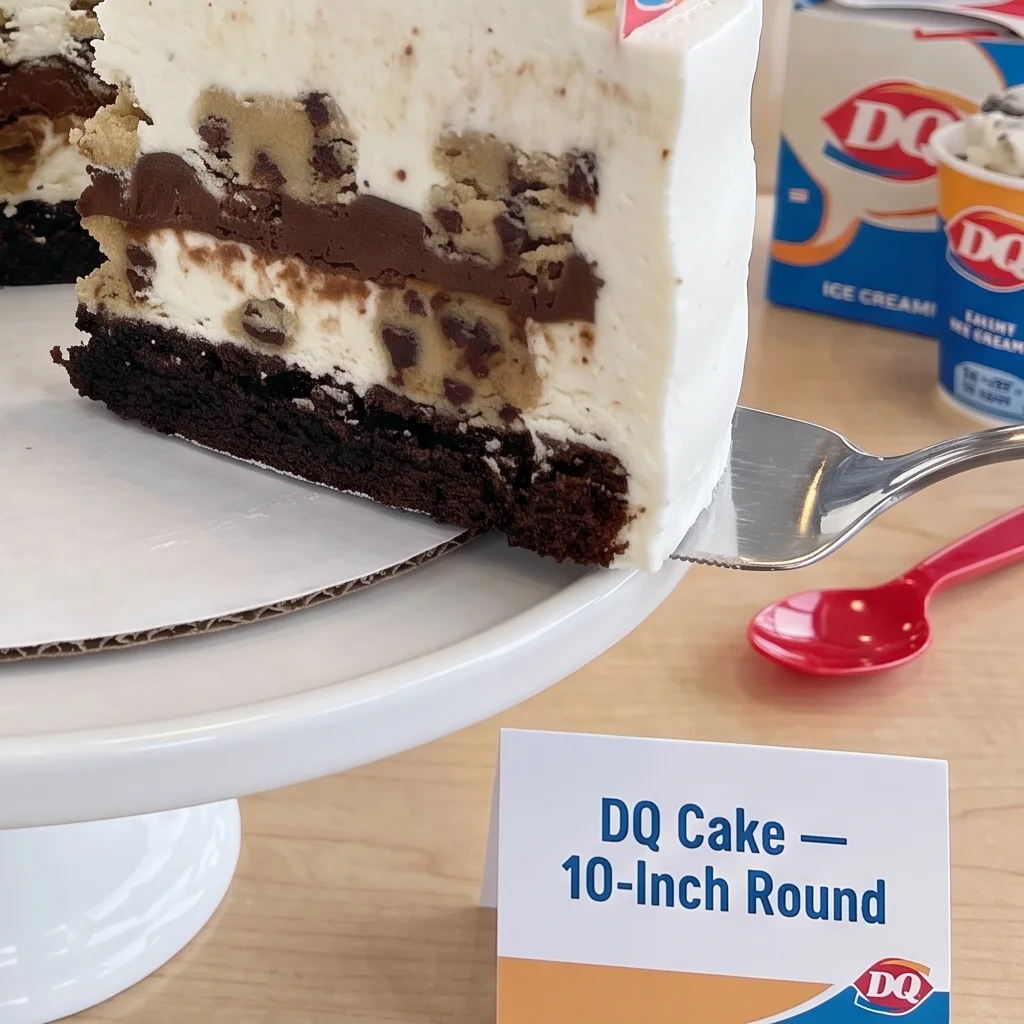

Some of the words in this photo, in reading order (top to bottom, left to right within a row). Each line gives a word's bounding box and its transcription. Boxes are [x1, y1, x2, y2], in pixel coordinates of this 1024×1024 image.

[844, 99, 956, 166] DQ
[958, 218, 1024, 282] DQ
[822, 280, 856, 303] ICE
[601, 797, 661, 852] DQ
[677, 803, 785, 856] Cake
[562, 855, 729, 912] 10-Inch
[747, 869, 886, 924] Round
[866, 971, 921, 1004] DQ
